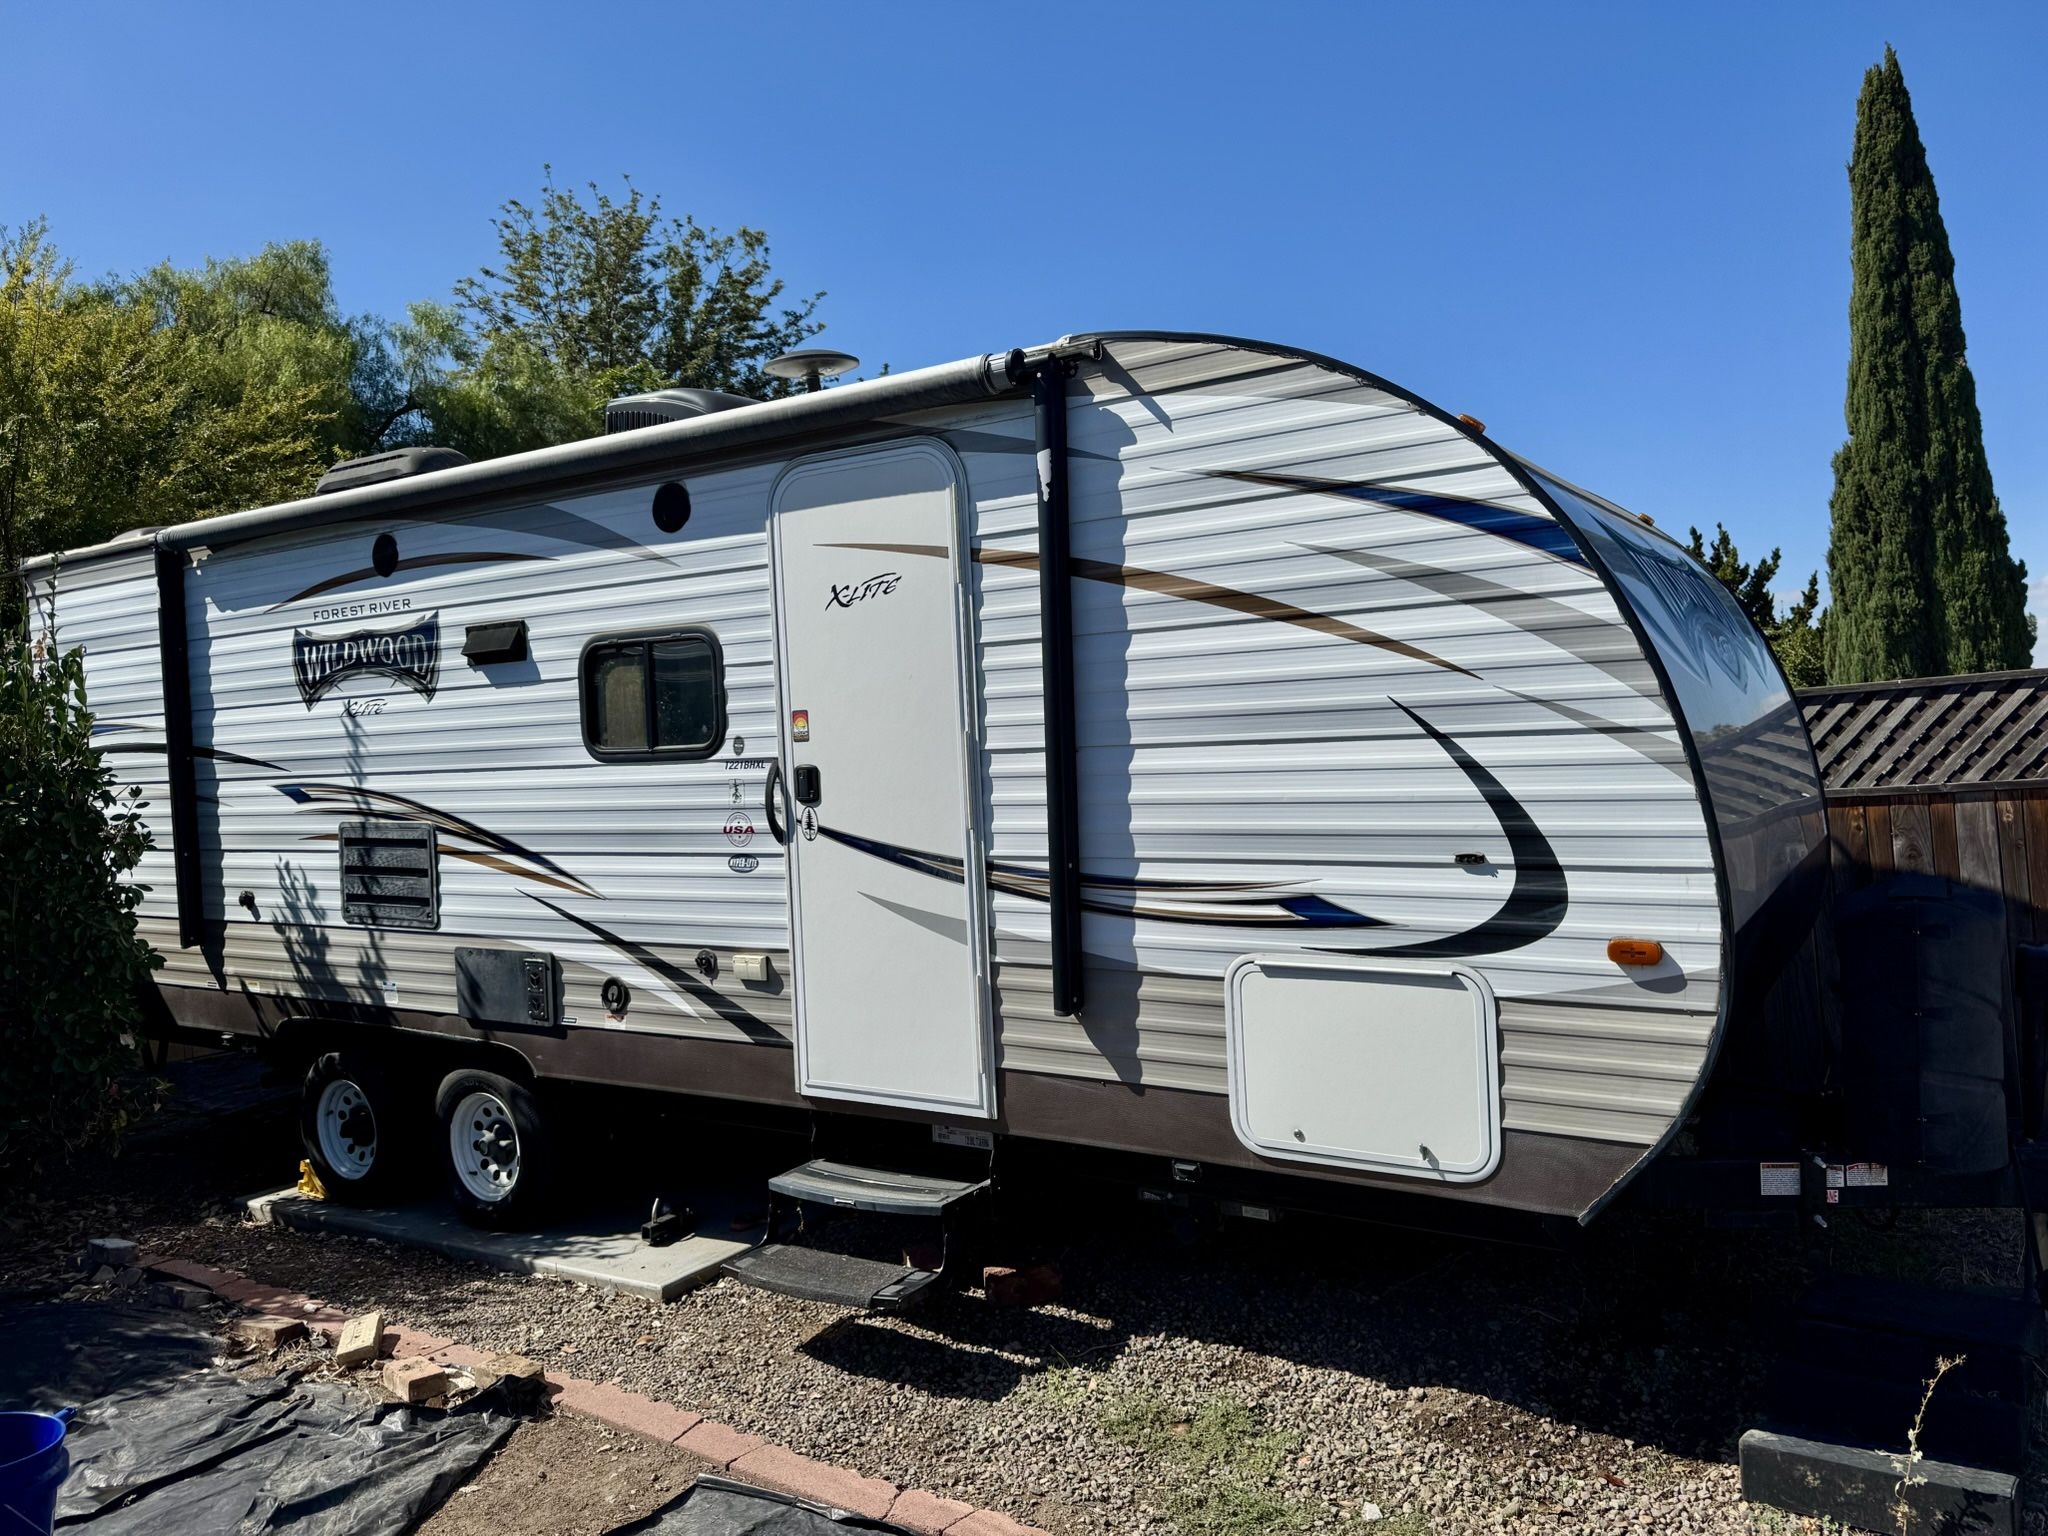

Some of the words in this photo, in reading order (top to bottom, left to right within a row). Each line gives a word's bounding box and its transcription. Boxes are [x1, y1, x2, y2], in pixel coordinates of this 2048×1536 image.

[824, 572, 902, 612] X-LITE
[313, 604, 365, 622] FOREST
[369, 599, 411, 614] RIVER
[303, 634, 428, 685] WILDWOOD
[340, 698, 388, 719] X-LITE
[723, 825, 756, 834] USA
